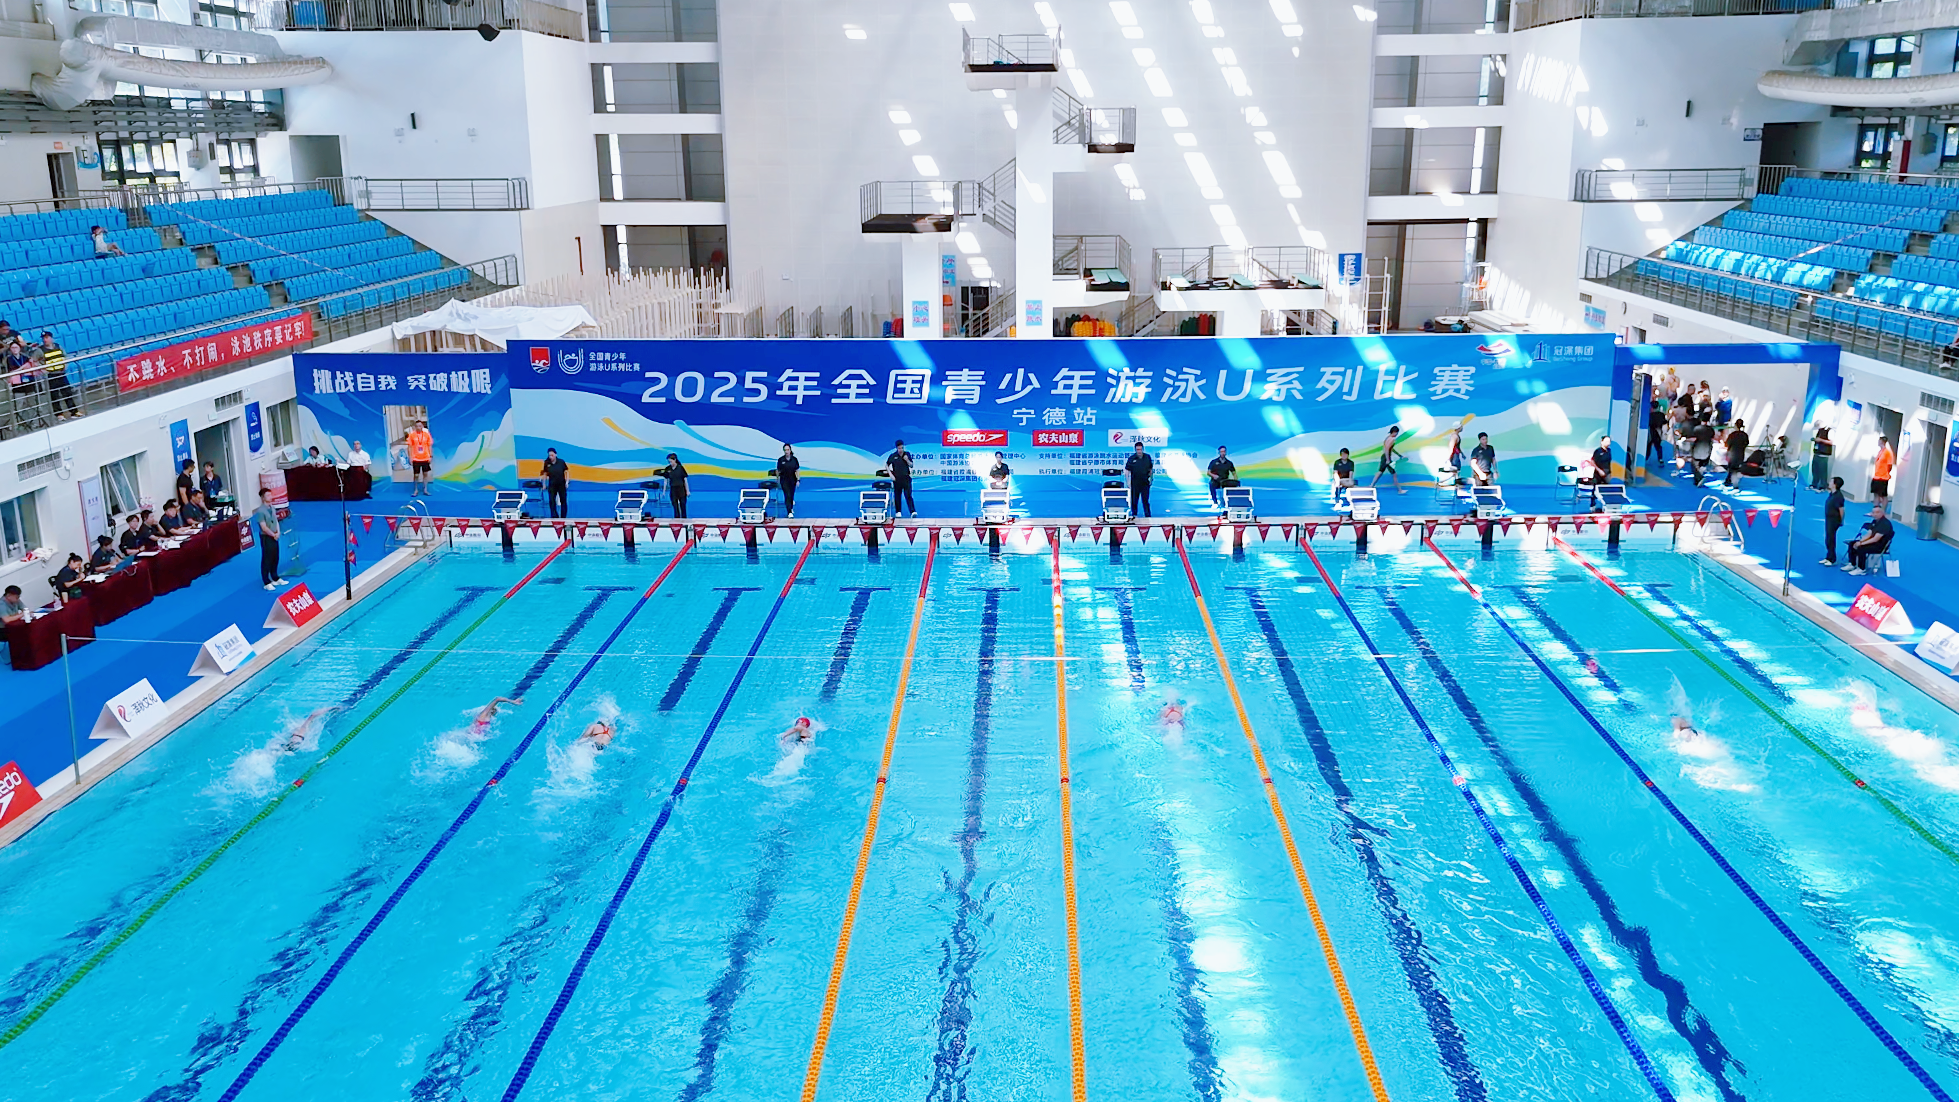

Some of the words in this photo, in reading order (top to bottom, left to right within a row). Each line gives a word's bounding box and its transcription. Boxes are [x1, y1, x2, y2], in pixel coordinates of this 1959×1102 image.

[588, 351, 627, 361] 全国青少年
[589, 362, 641, 372] 游泳U系列比赛
[312, 368, 398, 394] 挑战自我
[407, 368, 492, 395] 突破极限
[641, 364, 1476, 405] 2025年全国青少年游泳U系列比赛
[1012, 407, 1098, 426] 宁德站
[946, 432, 986, 445] speedo
[1038, 432, 1079, 444] 农夫山泉
[0, 771, 22, 796] edo
